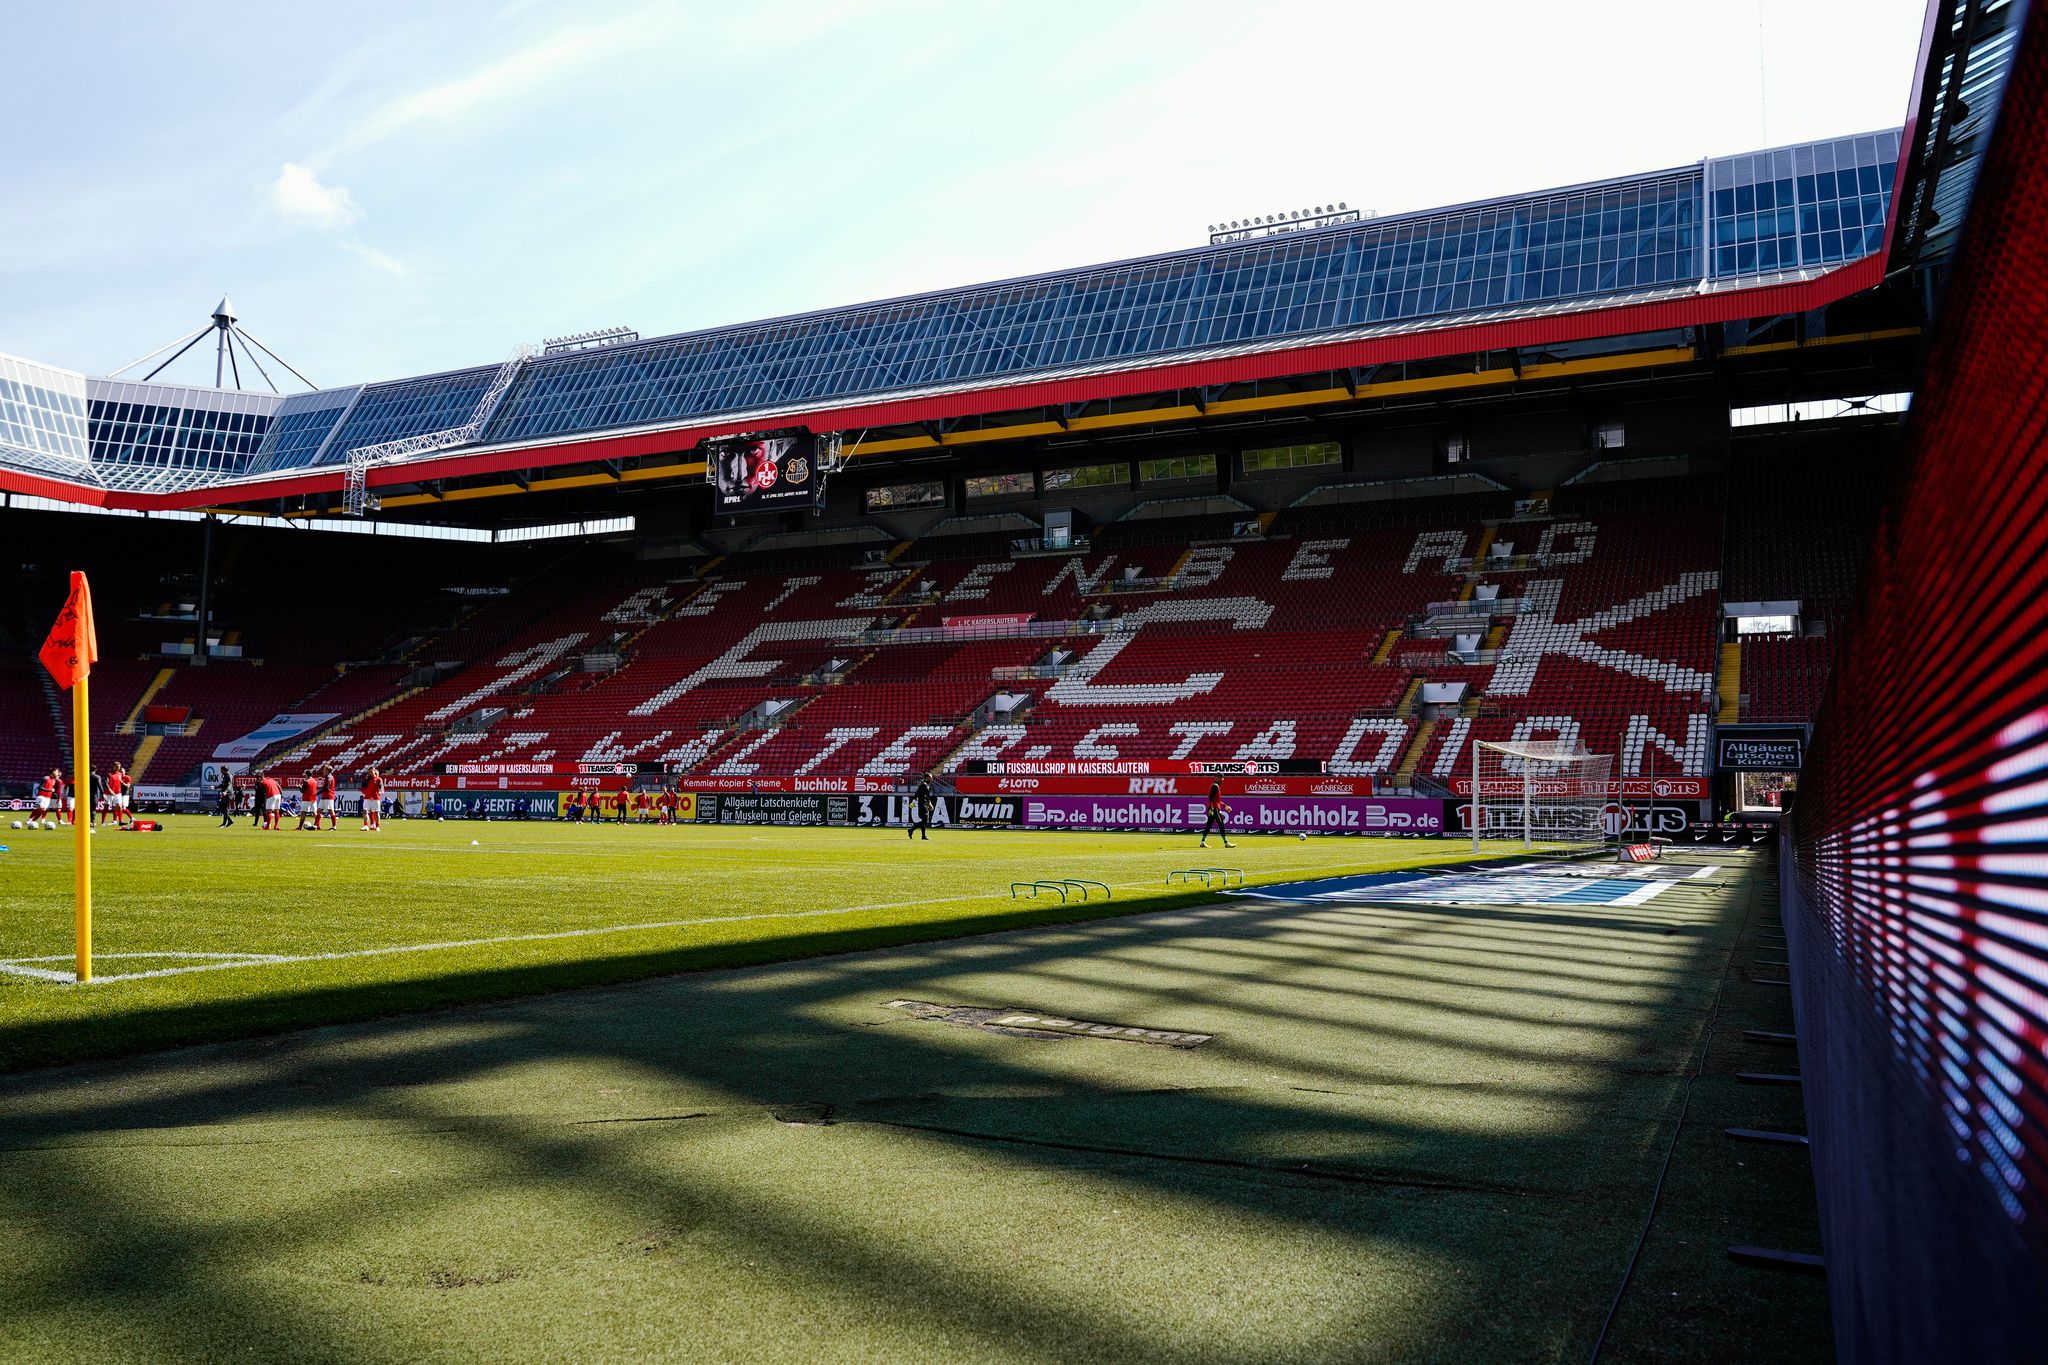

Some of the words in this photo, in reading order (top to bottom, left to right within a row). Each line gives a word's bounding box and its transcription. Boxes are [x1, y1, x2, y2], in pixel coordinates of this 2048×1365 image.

[971, 617, 1018, 626] KAISERSLAUTERN
[1727, 743, 1795, 753] Allgäuer
[1726, 751, 1795, 760] Latschen
[445, 764, 458, 774] DEIN
[459, 764, 498, 774] FUSSBALLSHOP
[506, 763, 553, 774] KAISERSLAUTERN
[987, 762, 1005, 774] DEIN
[1006, 762, 1066, 774] FUSSBALLSHOP
[1067, 762, 1076, 774] IN
[1077, 762, 1150, 774] KAISERSLAUTERN
[1189, 760, 1279, 775] 11TEAMSPORTS
[384, 778, 410, 787] Lahner
[411, 778, 430, 787] Forst
[579, 777, 601, 786] LOTTO
[683, 779, 717, 787] Kemmler
[794, 777, 848, 791] buchholz
[1010, 778, 1039, 788] LOTTO
[724, 796, 758, 809] Allgäuer
[760, 796, 819, 808] Latschenkiefer
[959, 796, 1014, 819] bwin
[721, 809, 733, 820] für
[735, 809, 768, 821] Muskeln
[770, 810, 786, 821] und
[788, 810, 822, 821] Gelenke
[1093, 803, 1182, 824] buchholz
[1259, 804, 1359, 826] buchholz
